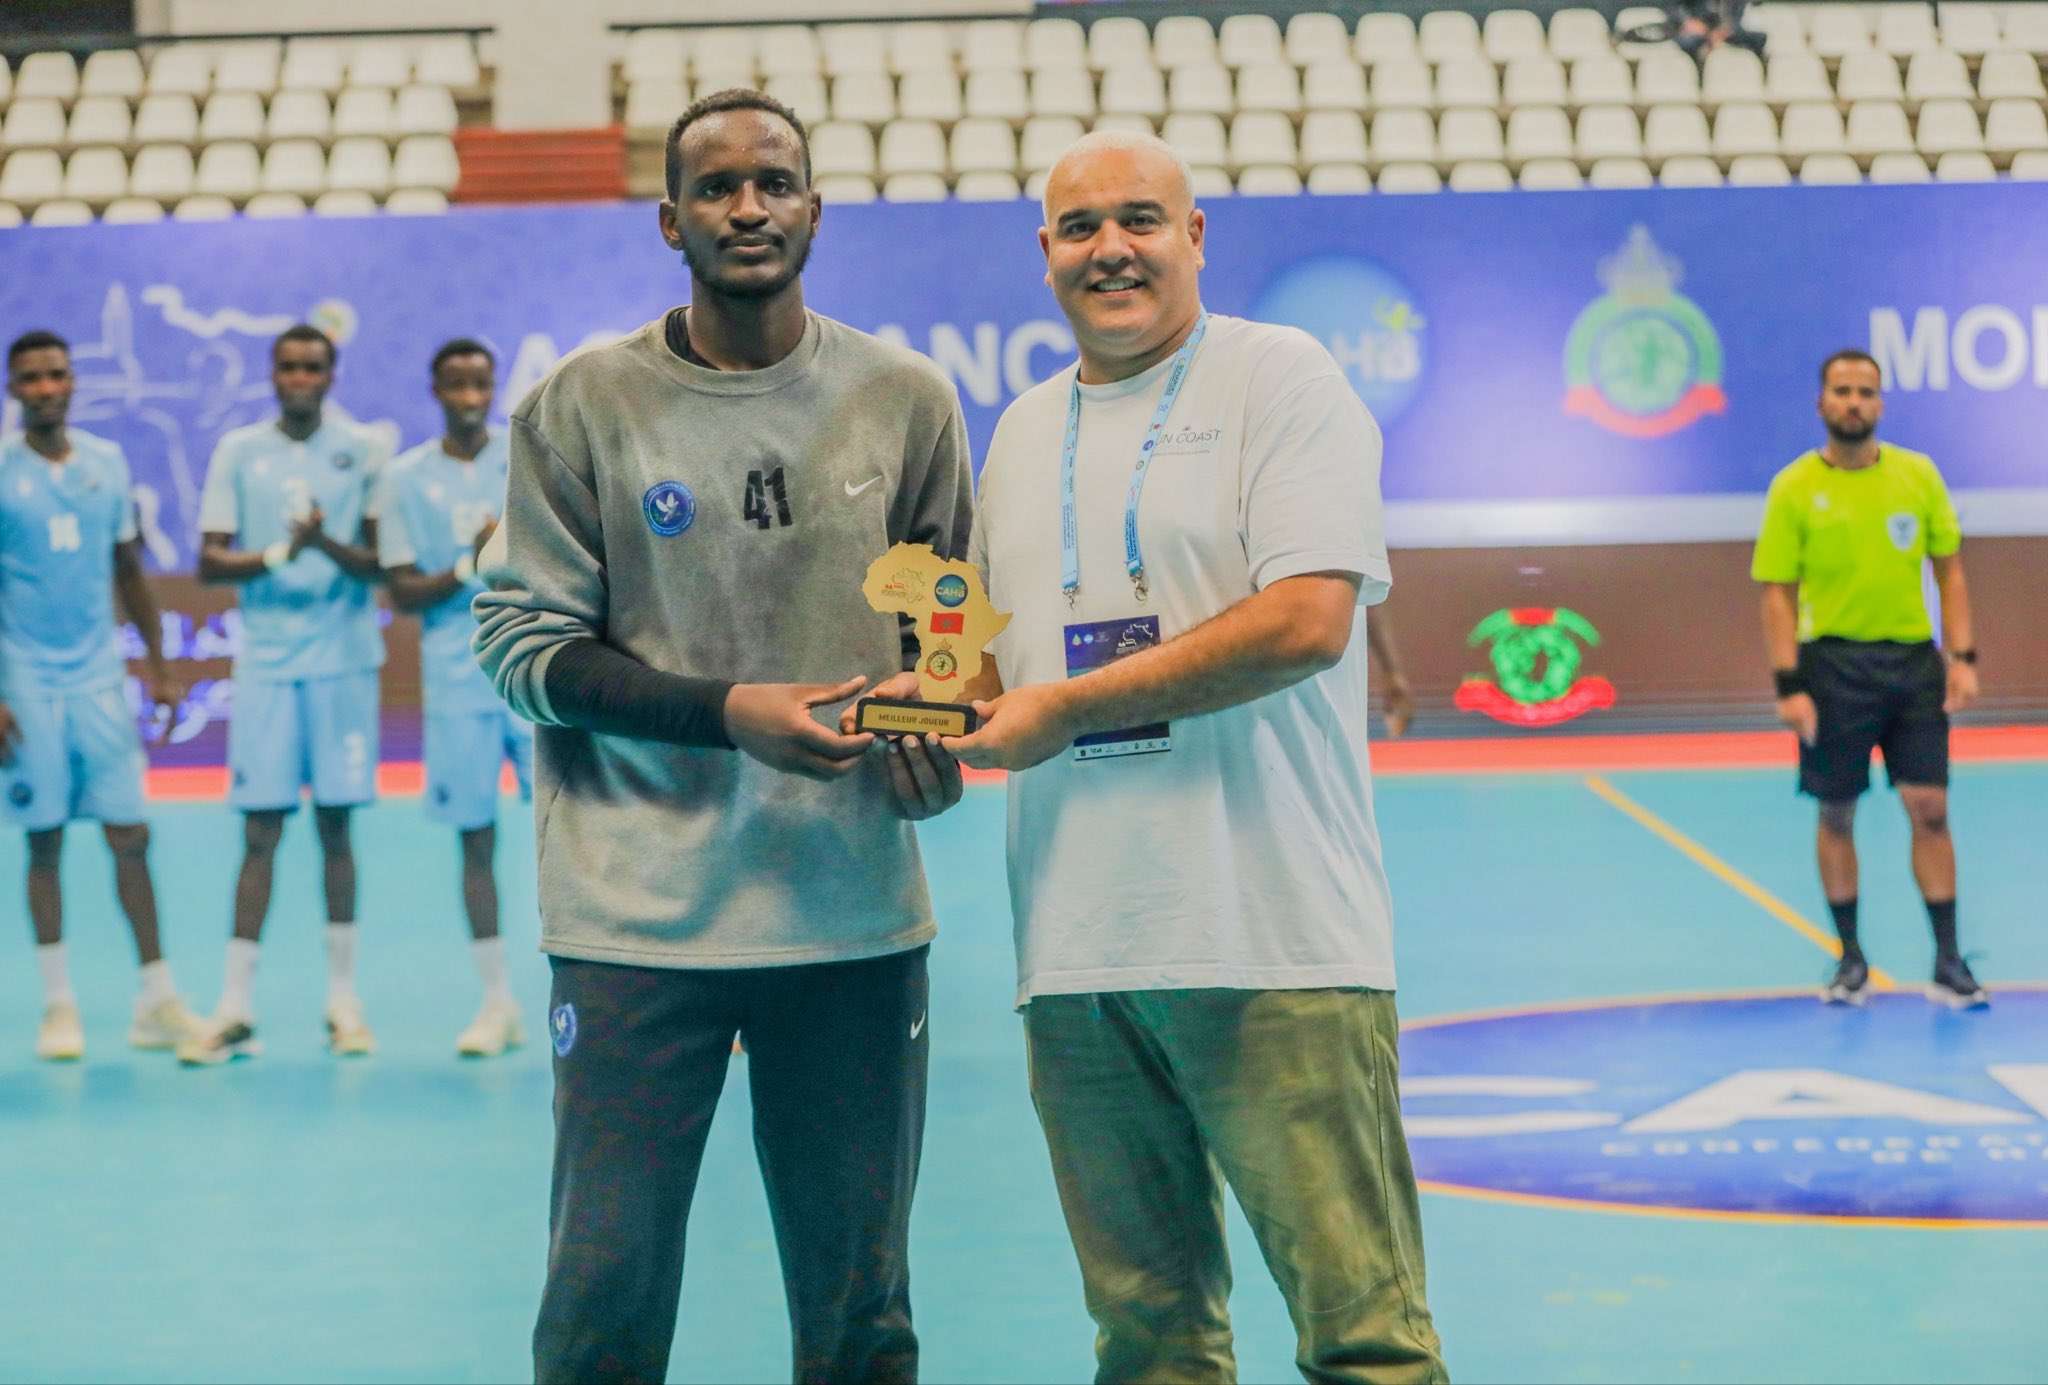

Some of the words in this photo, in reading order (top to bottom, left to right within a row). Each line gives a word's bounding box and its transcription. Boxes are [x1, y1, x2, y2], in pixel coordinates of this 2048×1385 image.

[1867, 304, 2048, 392] MO
[1176, 429, 1222, 444] COAST
[744, 467, 793, 530] 41
[878, 714, 917, 724] MEILLEUR
[918, 717, 949, 726] JOUEUR
